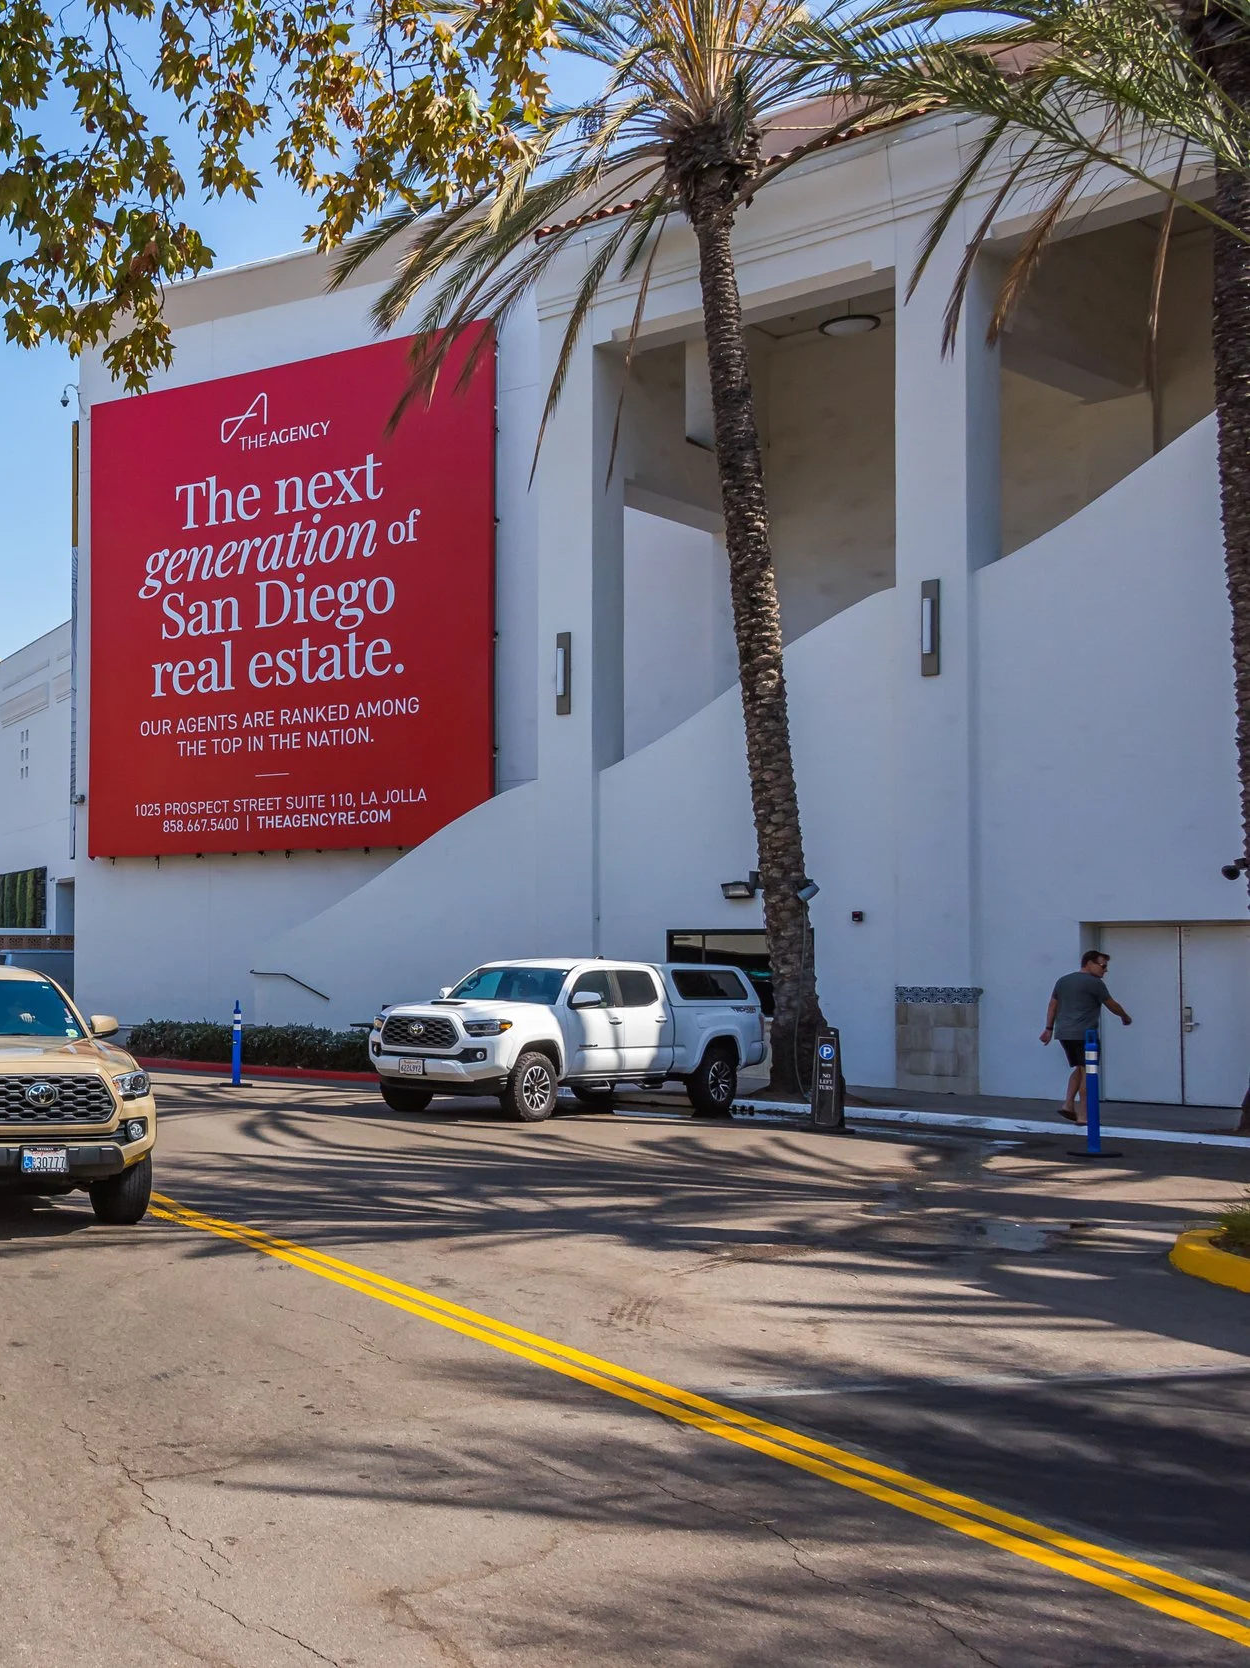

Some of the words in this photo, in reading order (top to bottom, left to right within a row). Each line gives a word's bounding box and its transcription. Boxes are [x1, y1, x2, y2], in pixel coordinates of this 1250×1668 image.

[175, 475, 261, 530] The
[274, 453, 384, 516] next
[138, 513, 378, 600] generation
[387, 508, 421, 545] of
[161, 591, 242, 640] San
[255, 573, 396, 631] Diego
[151, 640, 236, 698] real
[249, 631, 405, 689] estate.
[140, 719, 172, 737] OUR
[176, 714, 238, 734] AGENTS
[242, 711, 275, 729] ARE
[280, 704, 350, 726] RANKED
[355, 697, 420, 719] AMONG
[177, 740, 207, 757] THE
[211, 737, 243, 755] TOP
[248, 735, 264, 752] IN
[269, 732, 301, 750] THE
[307, 726, 375, 748] NATION.
[135, 803, 161, 817] 1025
[164, 800, 230, 816] PROSPECT
[233, 797, 283, 813] STREET
[285, 795, 326, 811] SUITE
[330, 793, 356, 809] 110,
[360, 791, 378, 806] LA
[381, 787, 427, 804] JOLLA
[162, 817, 239, 833] 858.667.5400
[257, 809, 391, 829] THEAGENCYRE.COM
[823, 1047, 831, 1057] P
